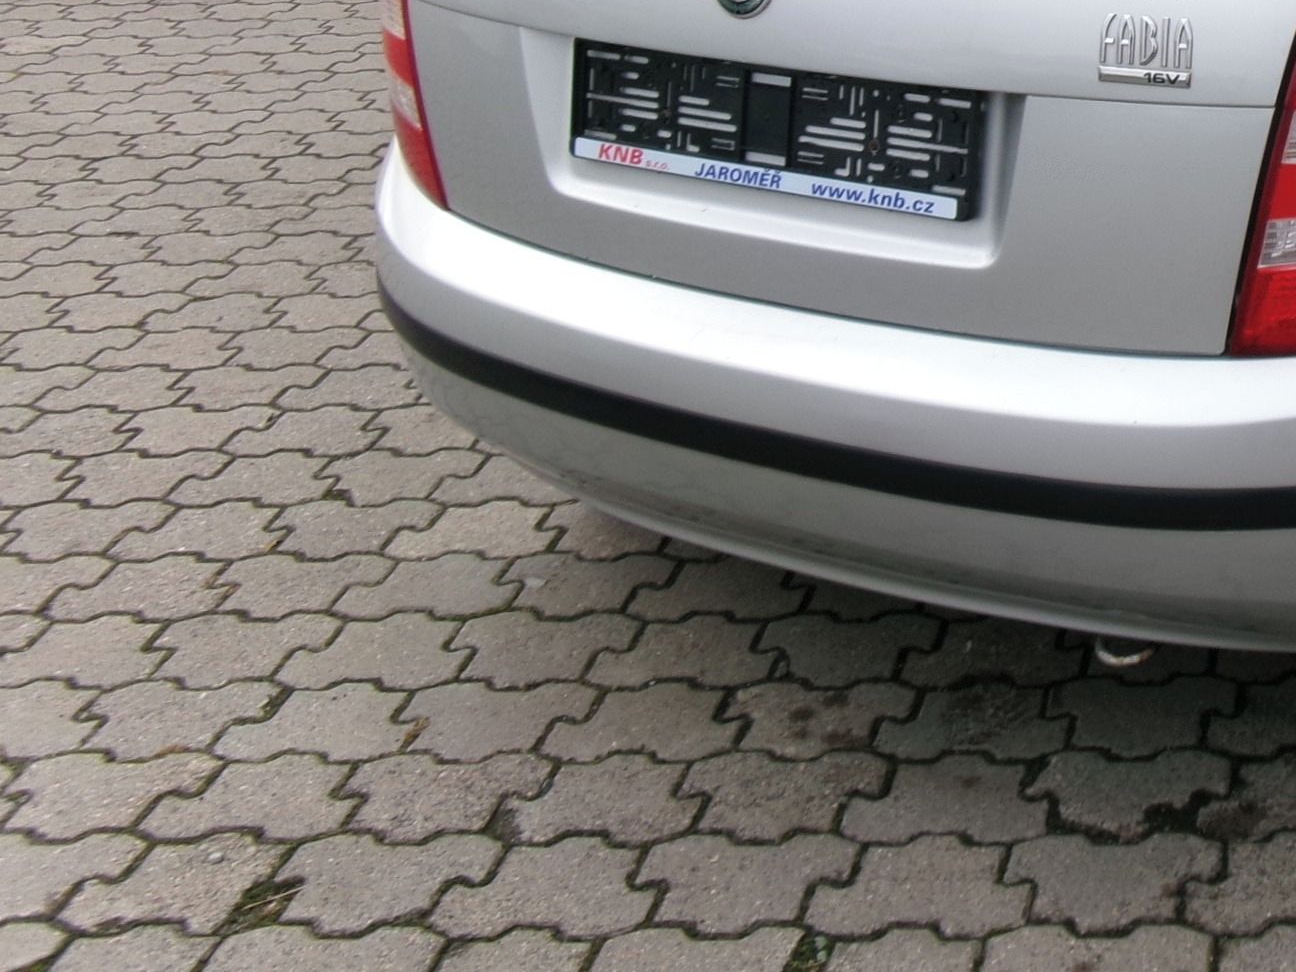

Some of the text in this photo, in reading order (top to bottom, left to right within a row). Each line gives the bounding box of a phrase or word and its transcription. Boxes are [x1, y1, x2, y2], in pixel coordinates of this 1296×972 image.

[1099, 12, 1193, 70] FABIA
[1143, 72, 1181, 85] 16V
[598, 143, 644, 165] KNB
[811, 182, 936, 214] www.knb.cz
